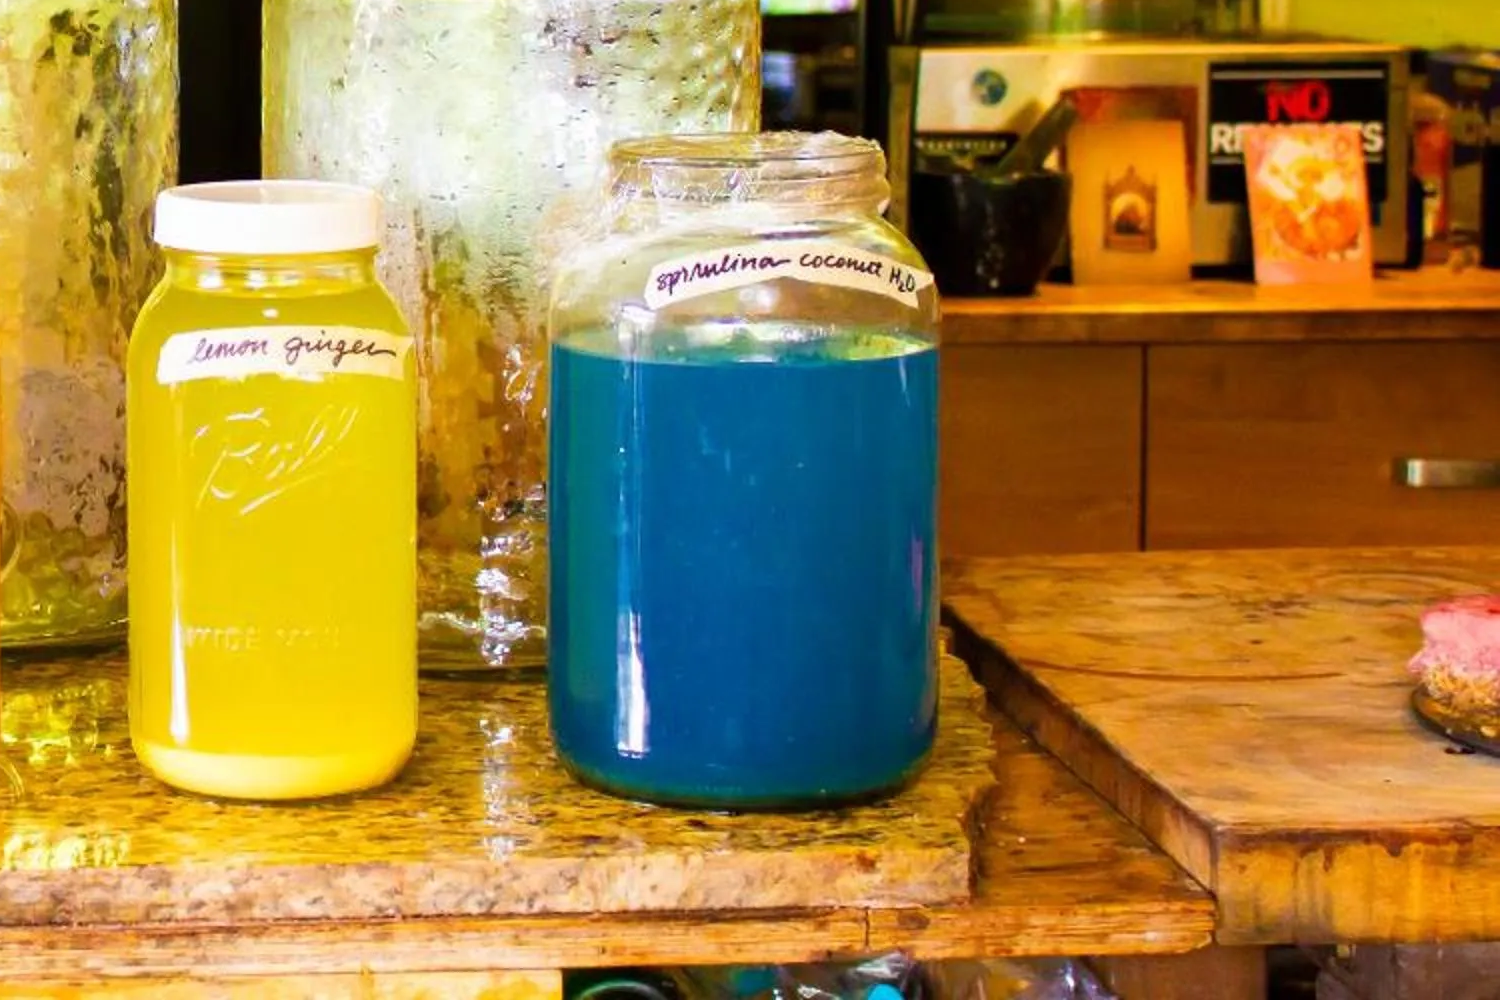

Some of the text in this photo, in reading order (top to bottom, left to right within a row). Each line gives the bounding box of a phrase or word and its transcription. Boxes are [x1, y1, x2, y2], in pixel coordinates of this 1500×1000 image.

[1266, 80, 1331, 122] NO
[799, 253, 883, 277] coconut
[187, 329, 397, 367] lemon ginger
